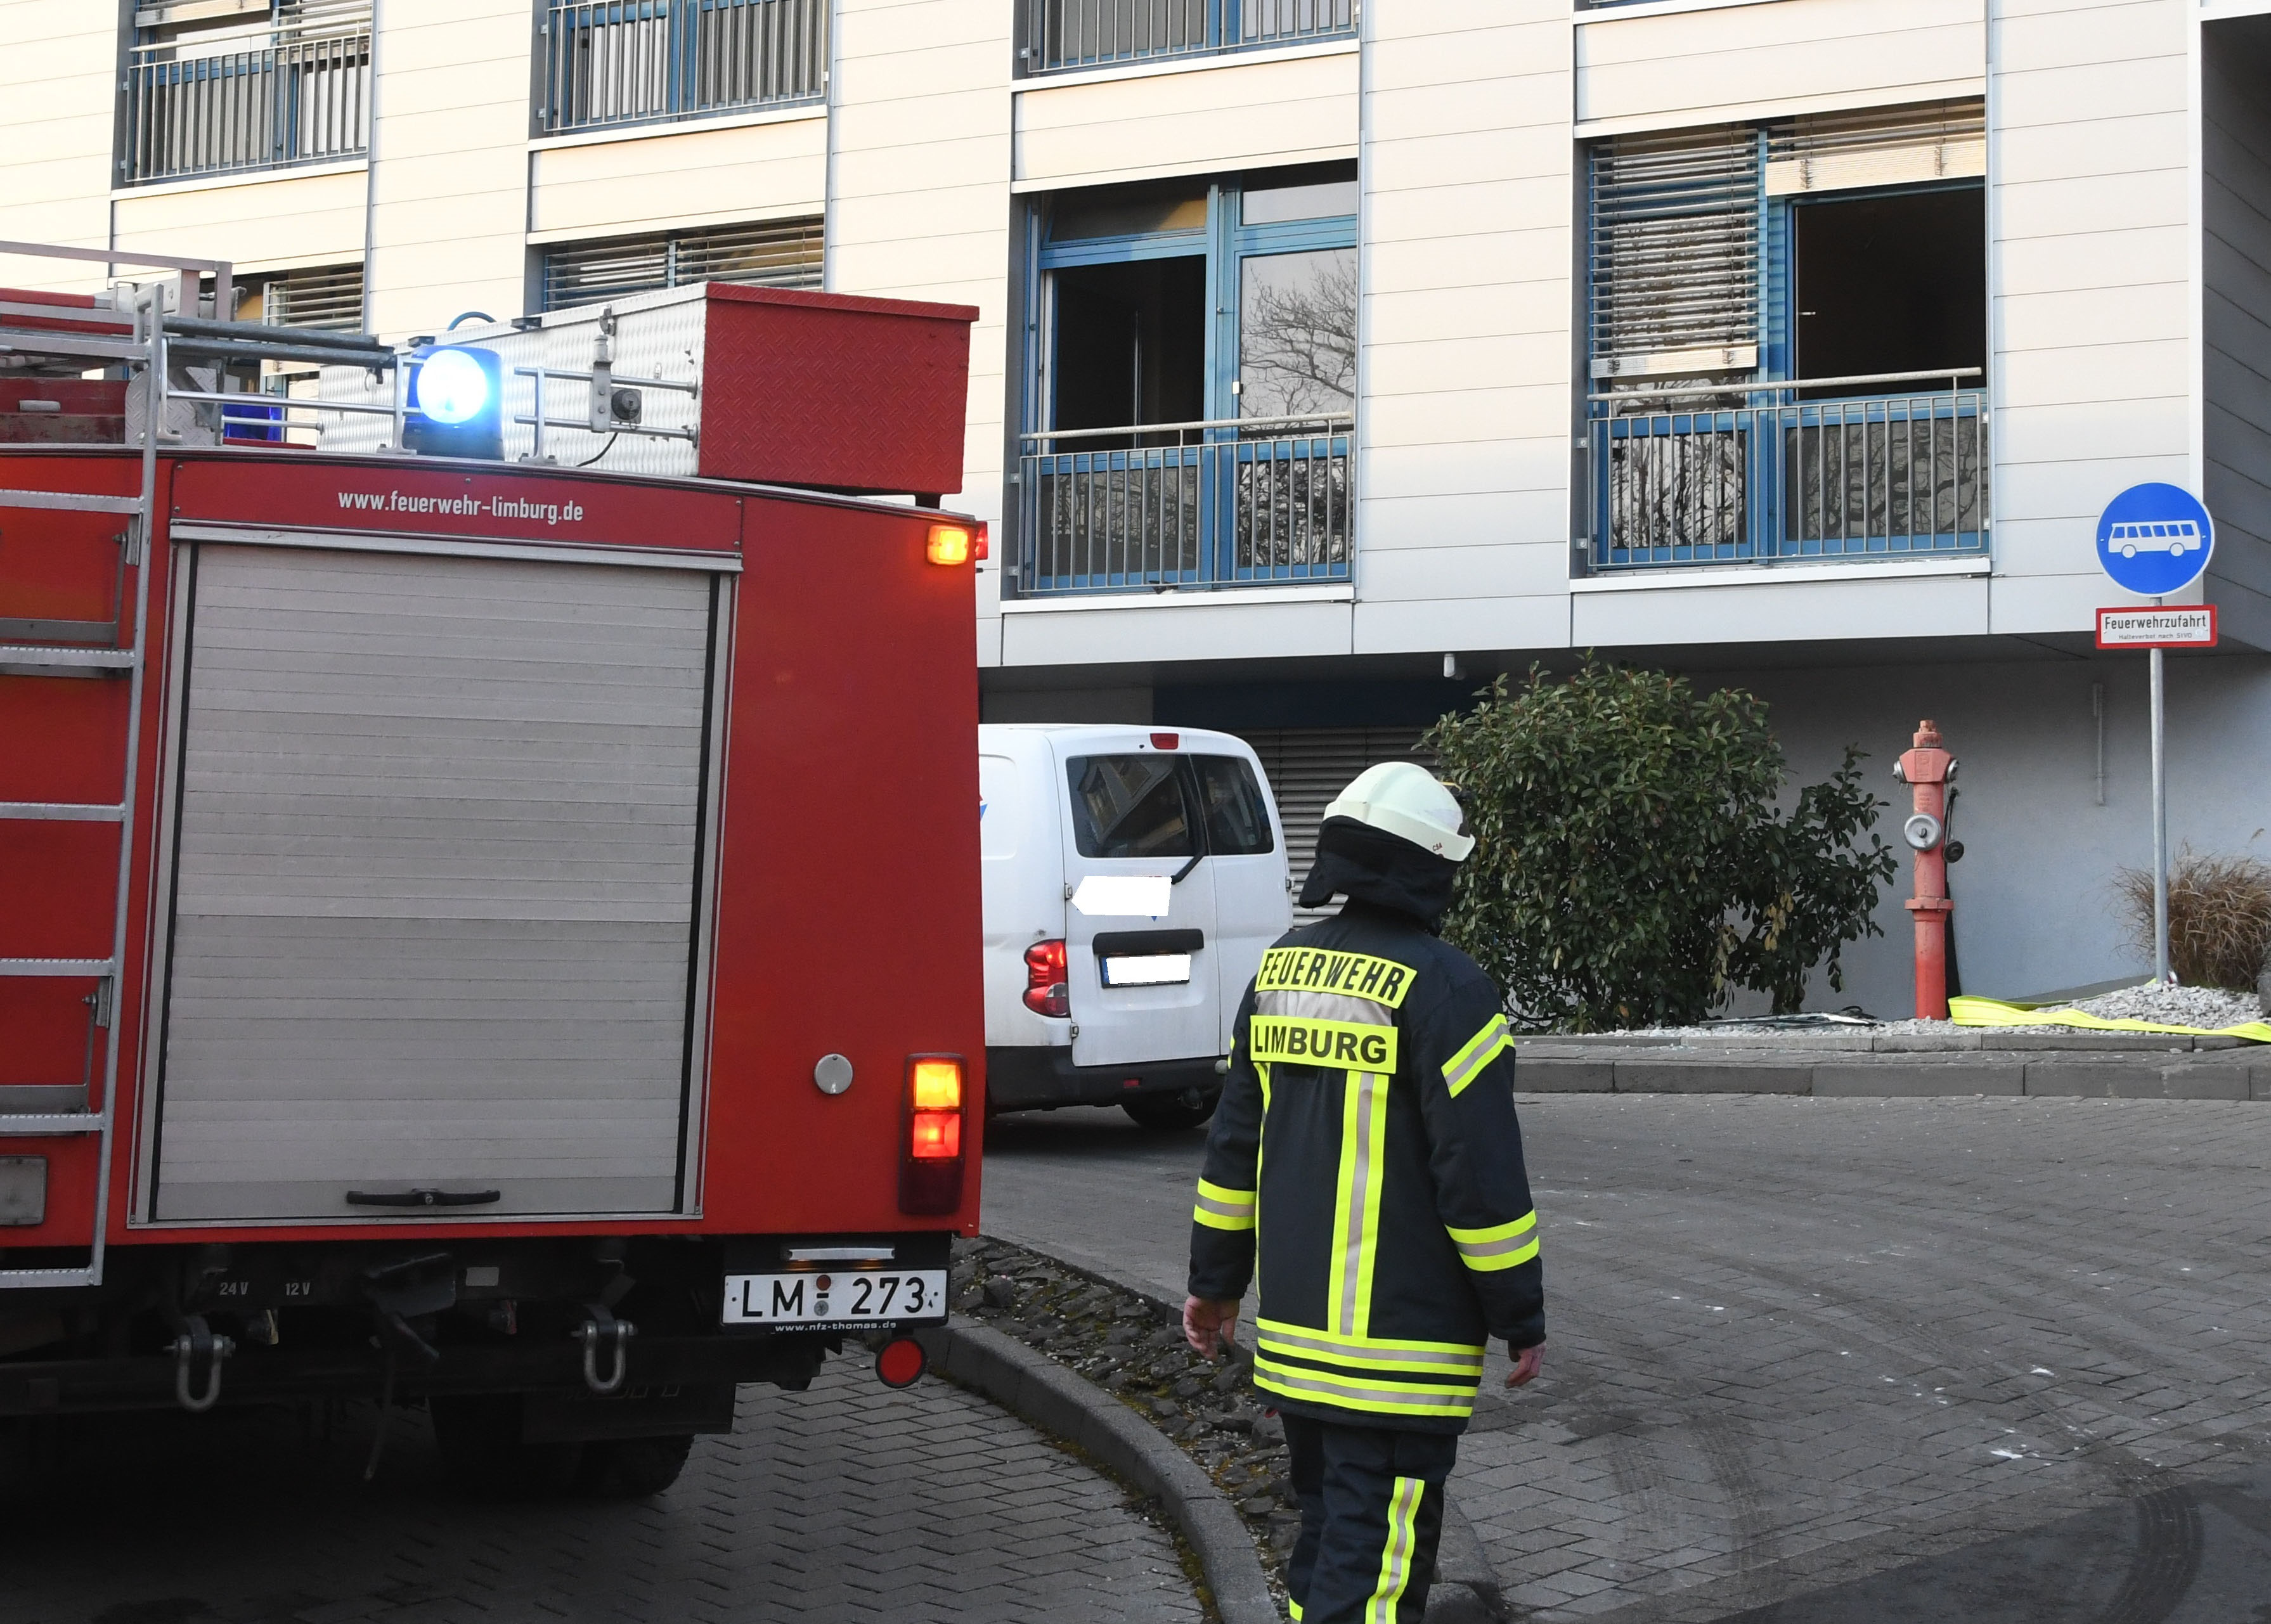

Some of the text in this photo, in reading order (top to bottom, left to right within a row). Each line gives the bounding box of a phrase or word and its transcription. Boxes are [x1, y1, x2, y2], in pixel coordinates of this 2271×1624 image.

[337, 490, 584, 525] www.feuerwehr-limburg.de
[2104, 614, 2206, 630] Feuerwehrzufahrt
[1257, 950, 1406, 1002] FEUERWEHR
[1254, 1024, 1387, 1064] LIMBURG
[219, 1282, 237, 1296] 24
[285, 1282, 300, 1296] 12
[742, 1277, 926, 1317] LM 273
[775, 1320, 897, 1332] www.nfz-thomas.de
